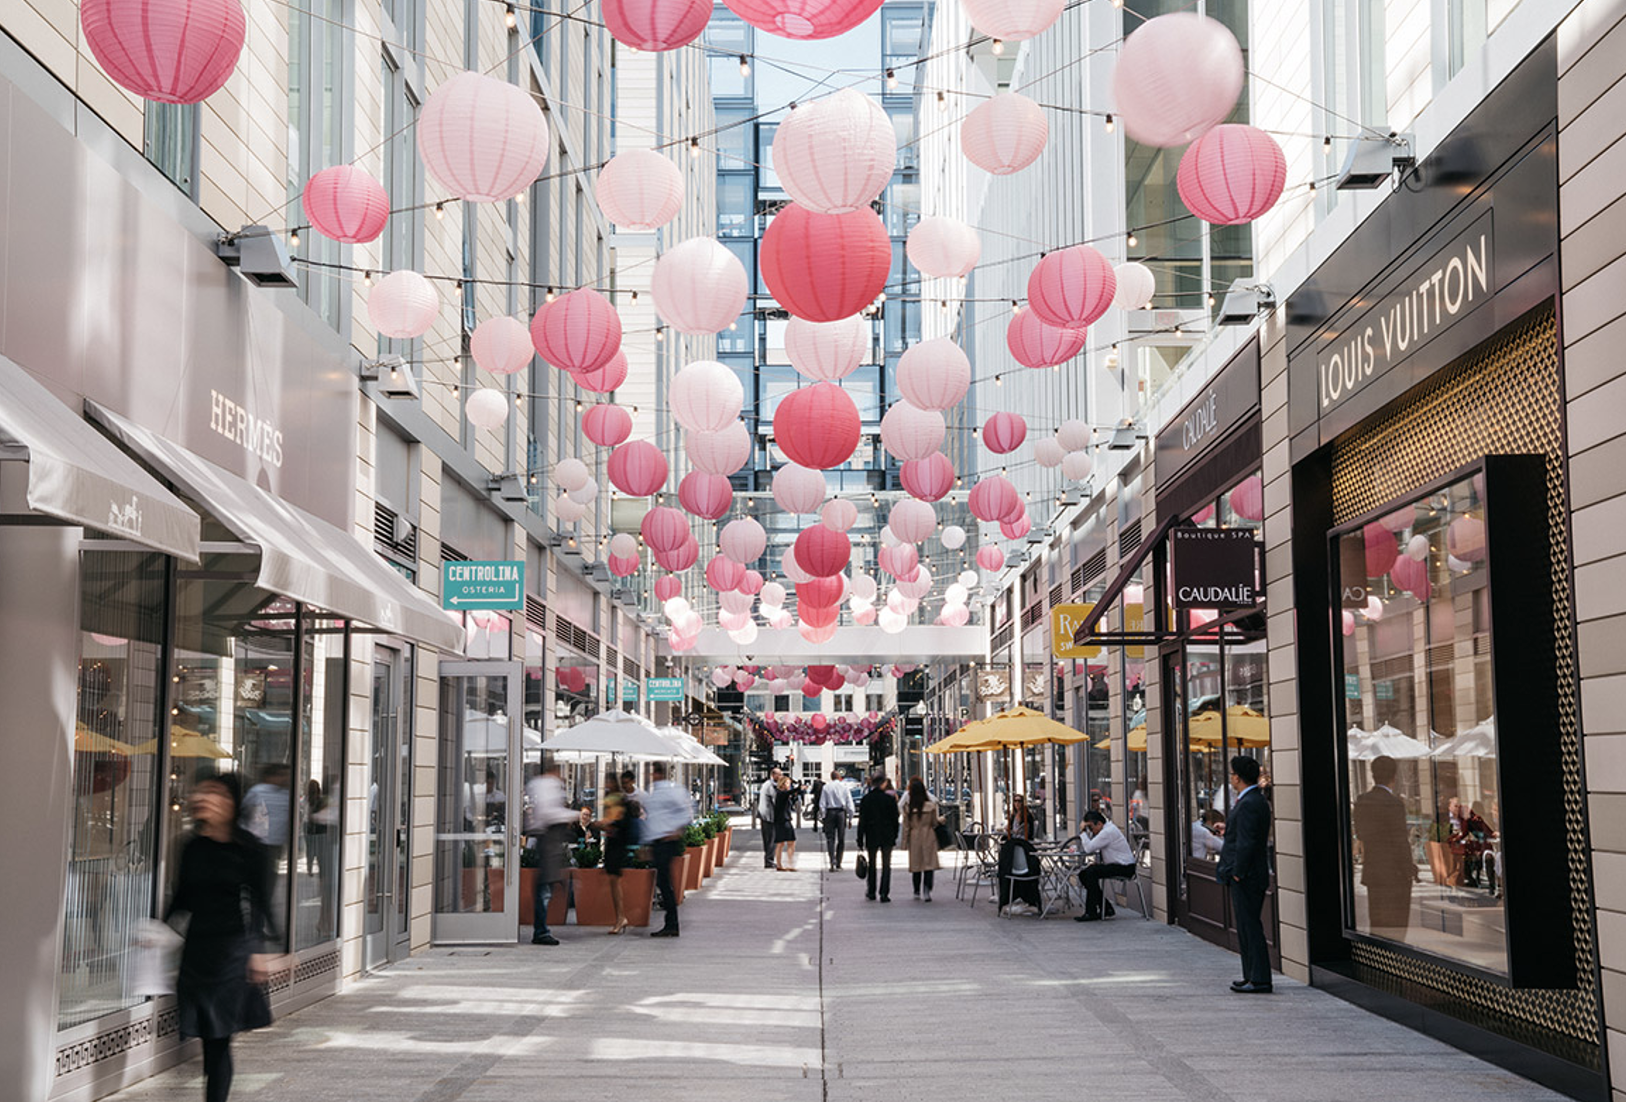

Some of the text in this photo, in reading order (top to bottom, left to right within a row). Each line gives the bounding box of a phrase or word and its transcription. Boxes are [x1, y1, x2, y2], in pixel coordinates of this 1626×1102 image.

[1321, 234, 1487, 407] LOUIS VUITTON
[210, 388, 283, 468] HERMÈS
[1177, 531, 1251, 540] Boutique SPA
[449, 565, 519, 581] CENTROLINA
[462, 586, 505, 594] OSTERIA
